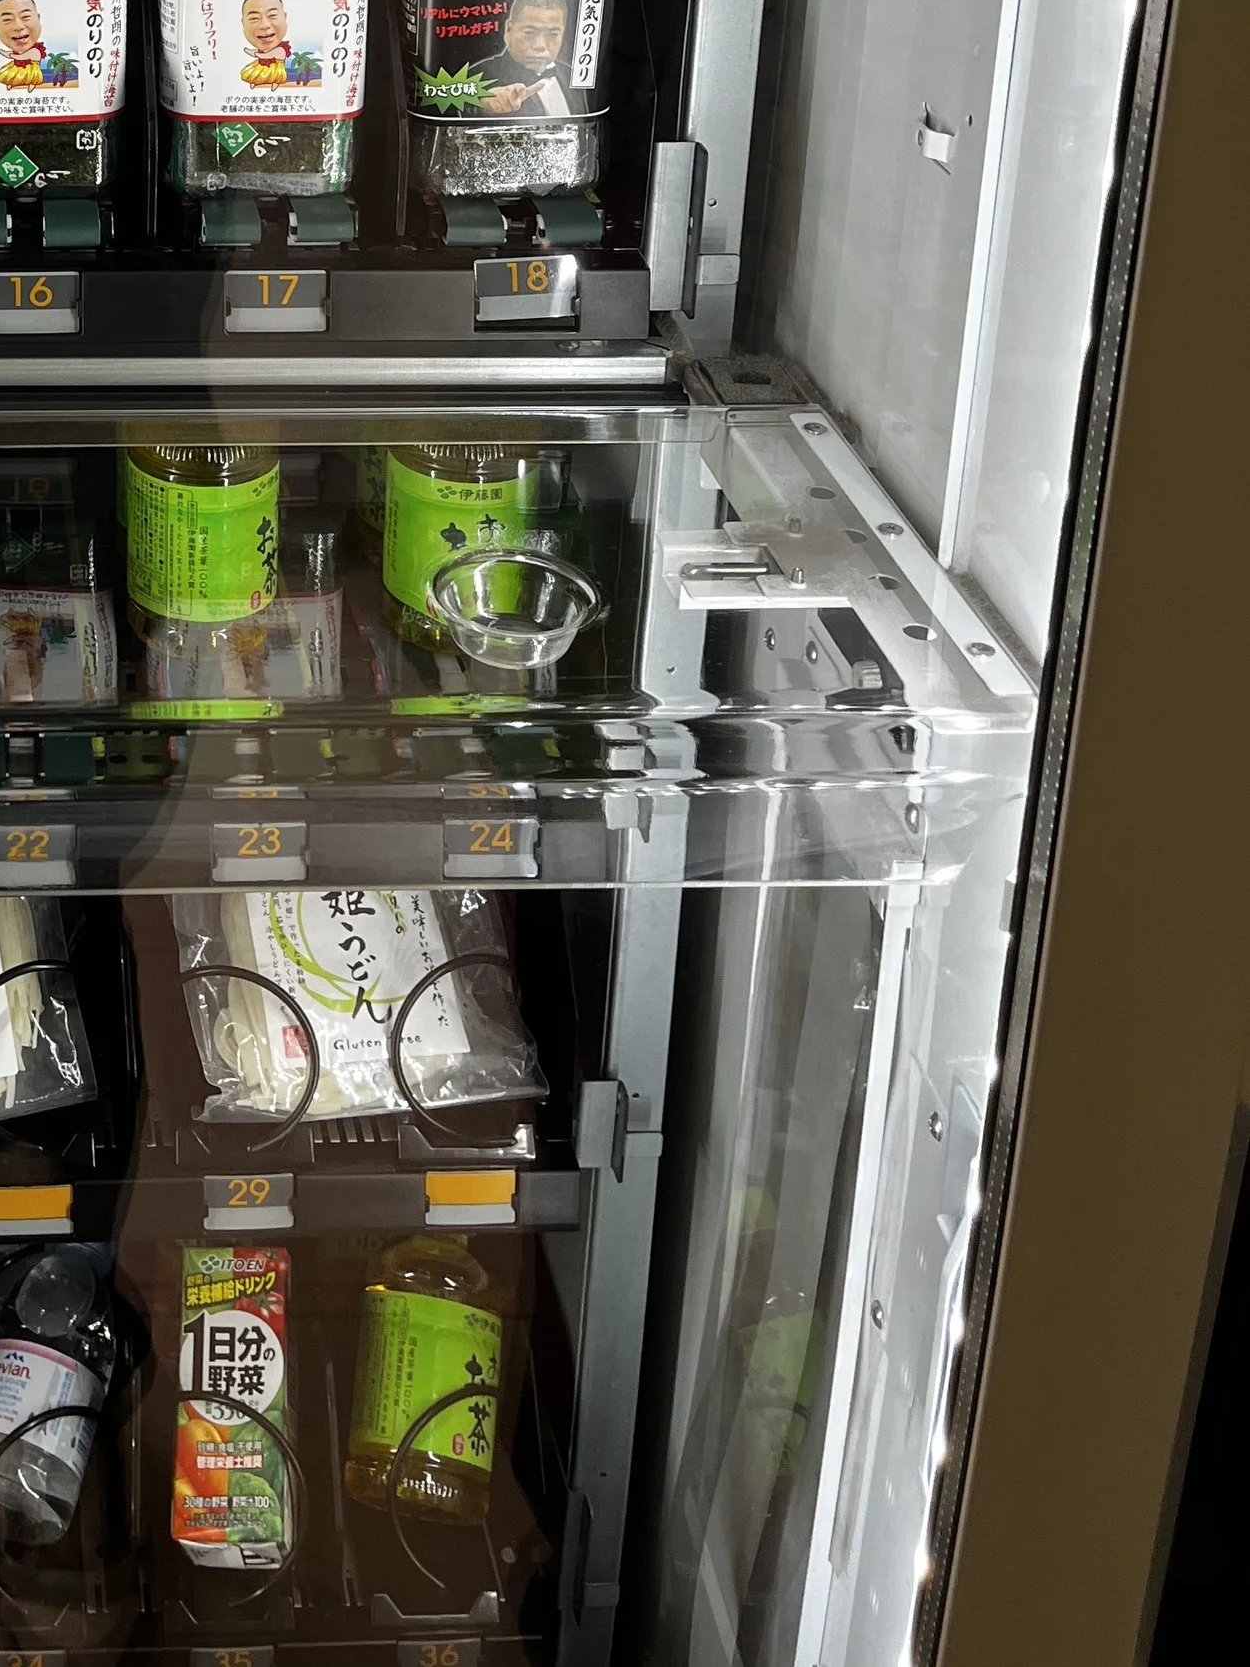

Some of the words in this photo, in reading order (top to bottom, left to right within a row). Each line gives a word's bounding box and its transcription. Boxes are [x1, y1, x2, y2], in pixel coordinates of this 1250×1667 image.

[420, 2, 508, 20] リアルにウマいよ!
[435, 20, 498, 38] リアルガチ!
[224, 95, 312, 105] ボクの実家の海苔です。
[424, 83, 478, 97] わさび味
[220, 104, 318, 114] 老舗の味をご賞味下さい。
[506, 262, 550, 293] 18
[10, 276, 53, 308] 16
[257, 275, 296, 306] 17
[459, 488, 503, 502] 伊藤園
[8, 830, 50, 862] 22
[238, 826, 282, 856] 23
[469, 822, 514, 852] 24
[333, 1038, 382, 1052] Gluten
[228, 1178, 270, 1206] 29
[220, 1259, 246, 1270] ITO
[246, 1258, 266, 1270] EN
[186, 1271, 276, 1306] 栄養補給ドリンク
[208, 1364, 266, 1395] 野菜
[419, 1644, 459, 1667] 36
